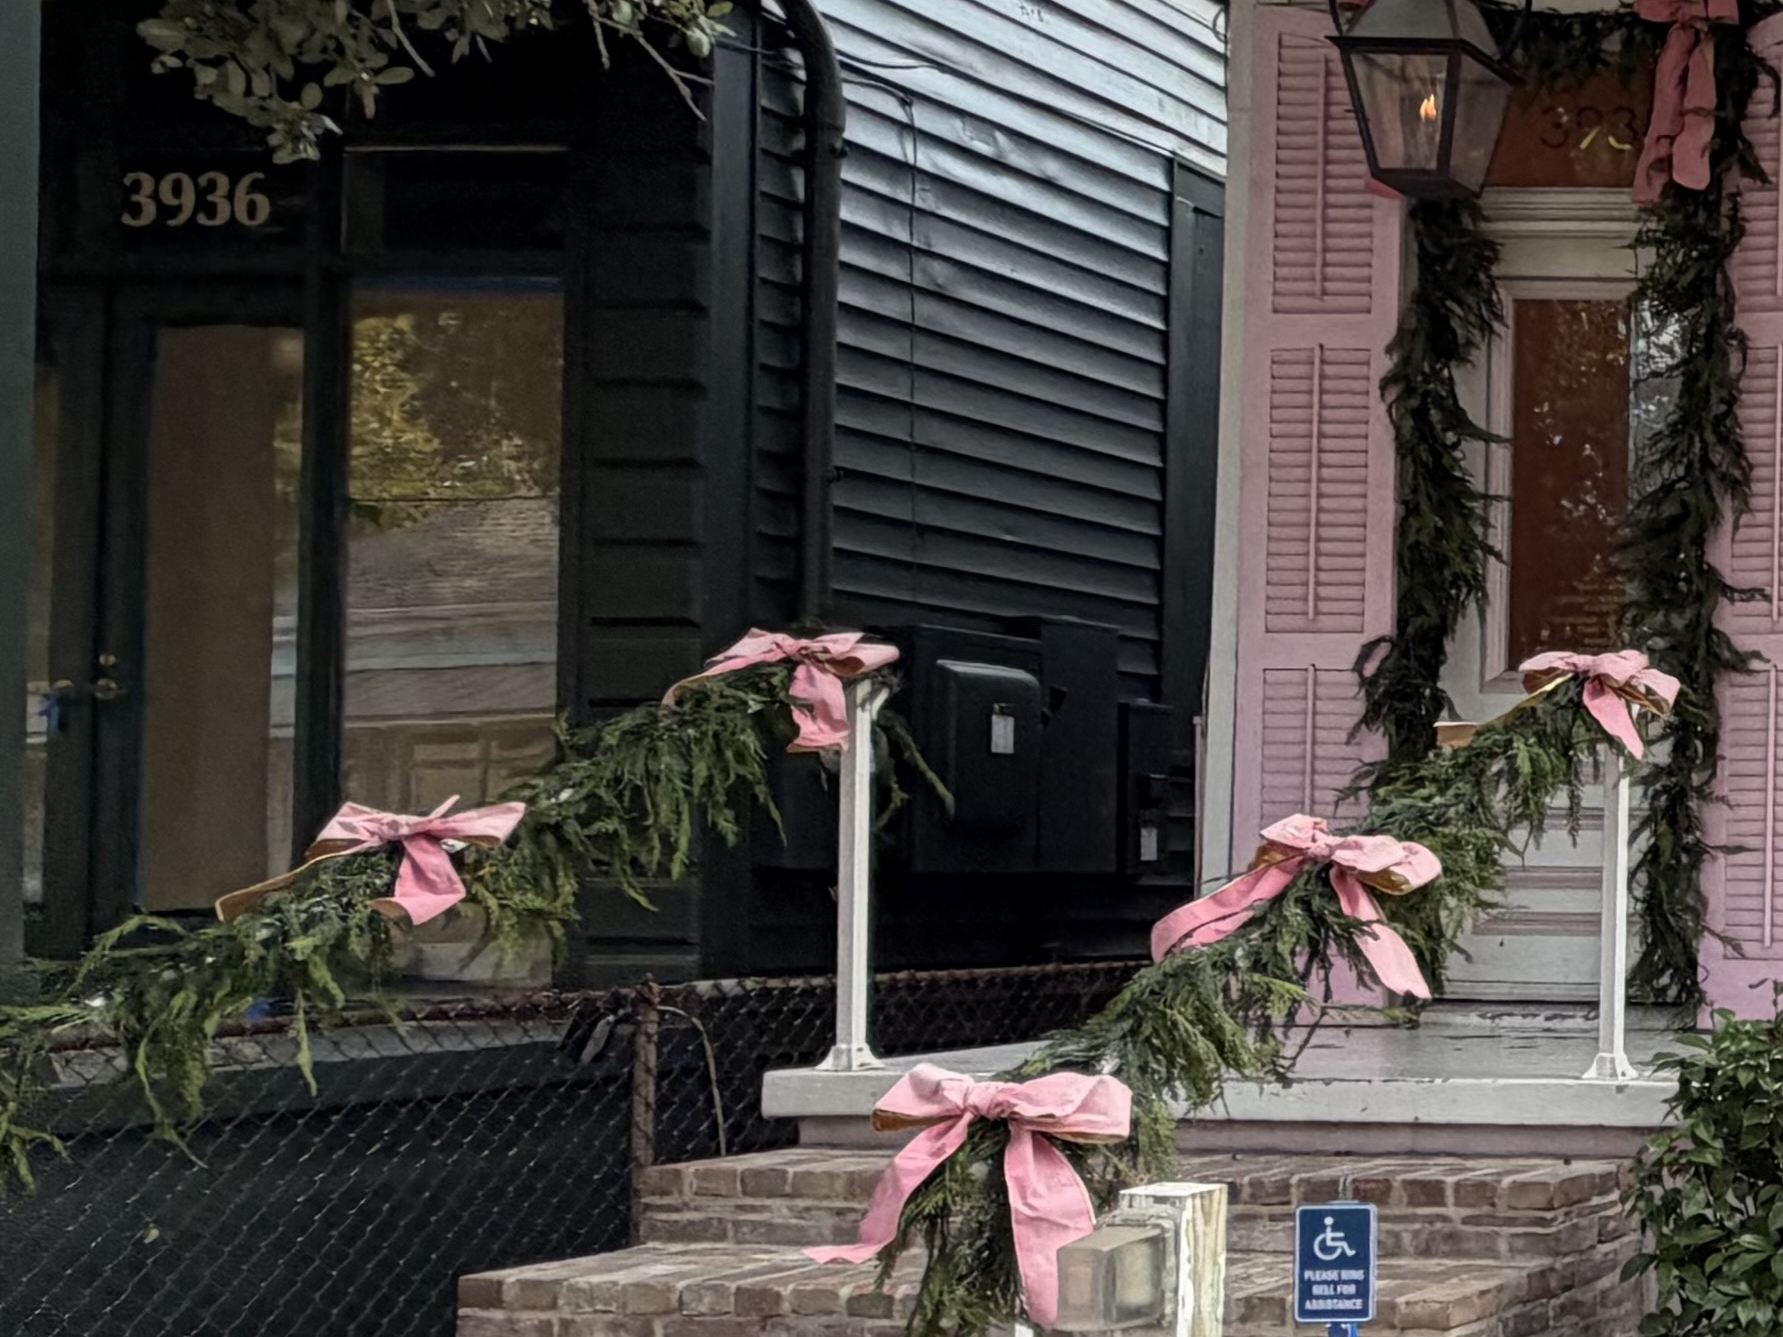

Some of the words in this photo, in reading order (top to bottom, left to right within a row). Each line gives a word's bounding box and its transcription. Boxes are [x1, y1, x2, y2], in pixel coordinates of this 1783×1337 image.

[121, 172, 272, 227] 3936
[1304, 1269, 1339, 1281] PLEASE
[1336, 1284, 1357, 1295] FOR
[1304, 1298, 1363, 1310] ASSISTANCE
